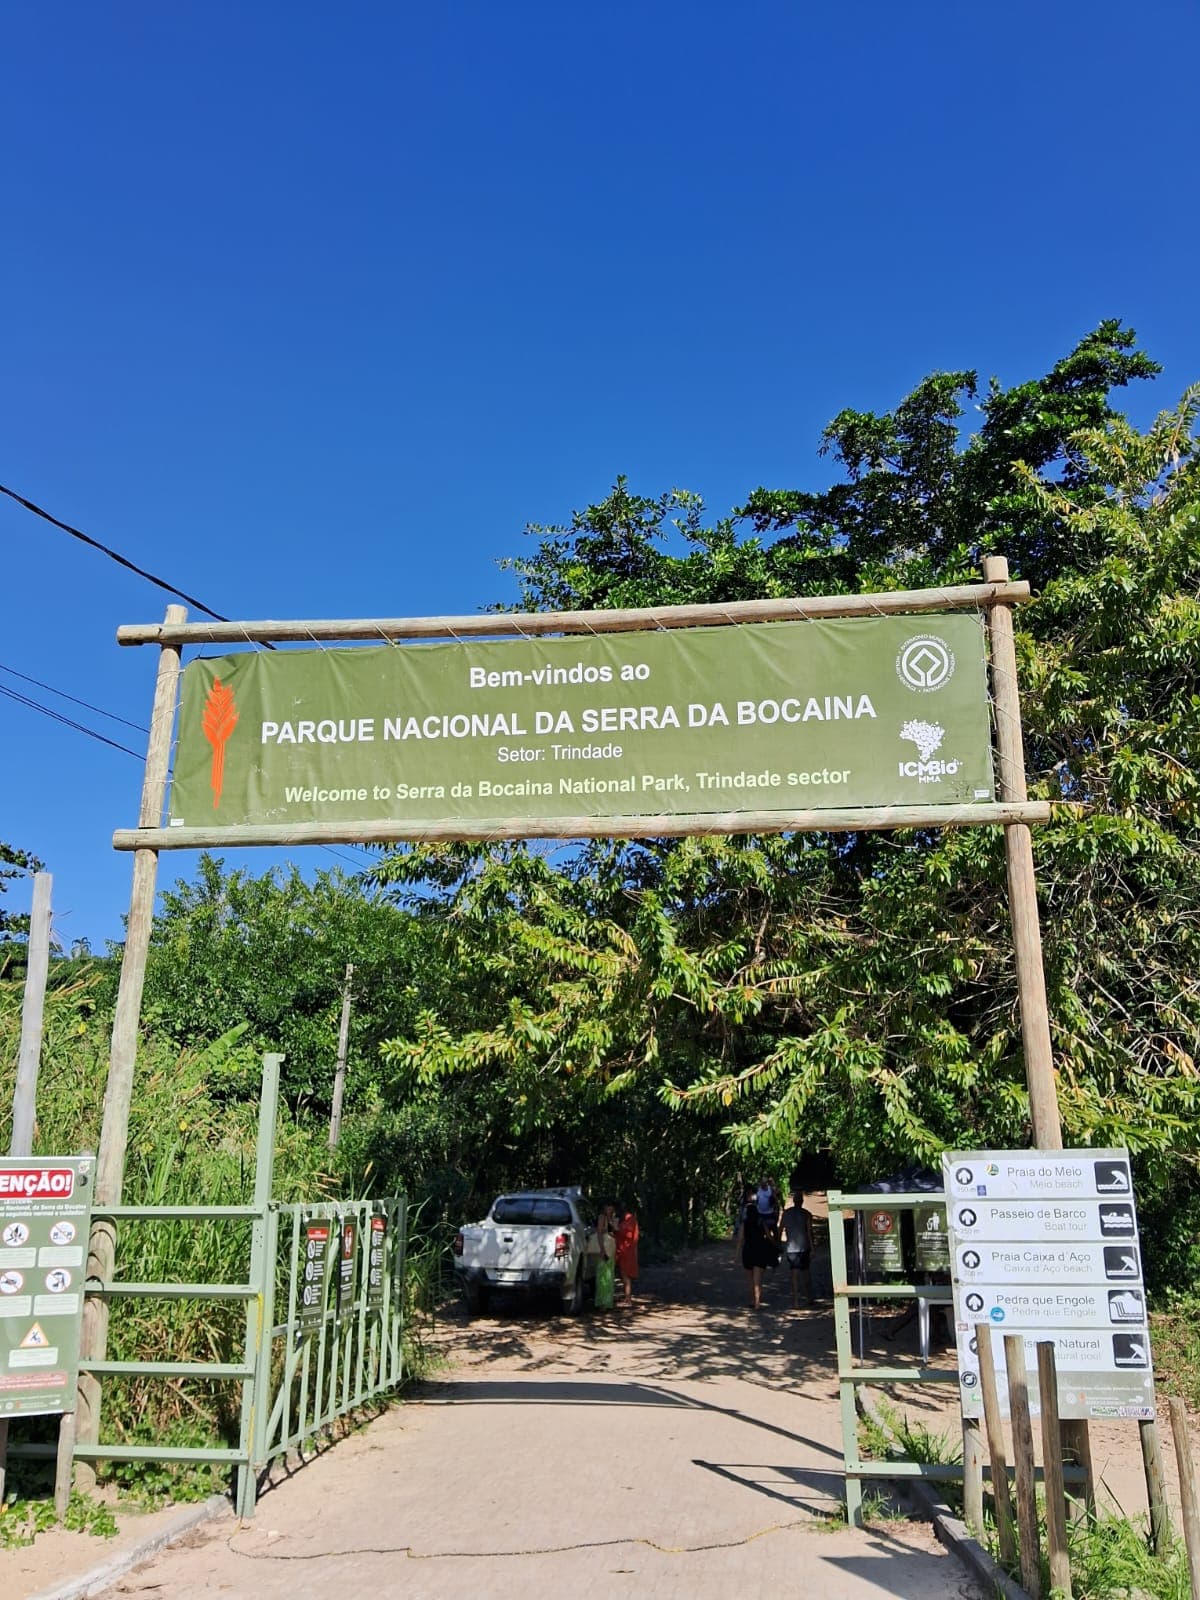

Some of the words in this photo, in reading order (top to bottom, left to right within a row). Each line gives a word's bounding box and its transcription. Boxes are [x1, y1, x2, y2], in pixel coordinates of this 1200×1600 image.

[470, 663, 612, 689] Bem-vindos
[620, 664, 650, 681] ao
[261, 719, 375, 745] PARQUE
[383, 712, 528, 741] NACIONAL
[535, 711, 575, 735] DA
[582, 705, 680, 733] SERRA
[687, 702, 730, 728] DA
[736, 694, 877, 726] BOCAINA
[496, 746, 546, 763] Setor:
[551, 743, 623, 761] Trindade
[899, 759, 958, 777] ICMBio
[285, 785, 368, 803] Welcome
[373, 786, 391, 801] to
[396, 784, 444, 801] Serra
[451, 782, 473, 799] da
[478, 780, 553, 797] Bocaina
[559, 776, 636, 795] National
[642, 774, 691, 794] Park,
[696, 771, 781, 791] Trindade
[787, 768, 851, 786] sector
[1007, 1167, 1035, 1177] Praia
[1038, 1167, 1051, 1177] do
[1055, 1166, 1082, 1177] Meio
[1030, 1180, 1052, 1189] Meio
[1055, 1180, 1083, 1189] beach
[991, 1209, 1034, 1219] Passeio
[1039, 1208, 1051, 1219] de
[1054, 1208, 1087, 1218] Barco
[1045, 1222, 1066, 1231] Boat
[1068, 1222, 1087, 1231] tour
[992, 1252, 1020, 1262] Praia
[1024, 1252, 1055, 1262] Caixa
[1004, 1264, 1031, 1273] Caixa
[1064, 1264, 1093, 1272] beach
[996, 1295, 1029, 1305] Pedra
[1033, 1296, 1053, 1307] que
[1056, 1295, 1095, 1307] Engole
[1012, 1307, 1040, 1316] Pedra
[1043, 1309, 1060, 1318] que
[1064, 1307, 1096, 1317] Engole
[1059, 1339, 1100, 1349] Natural
